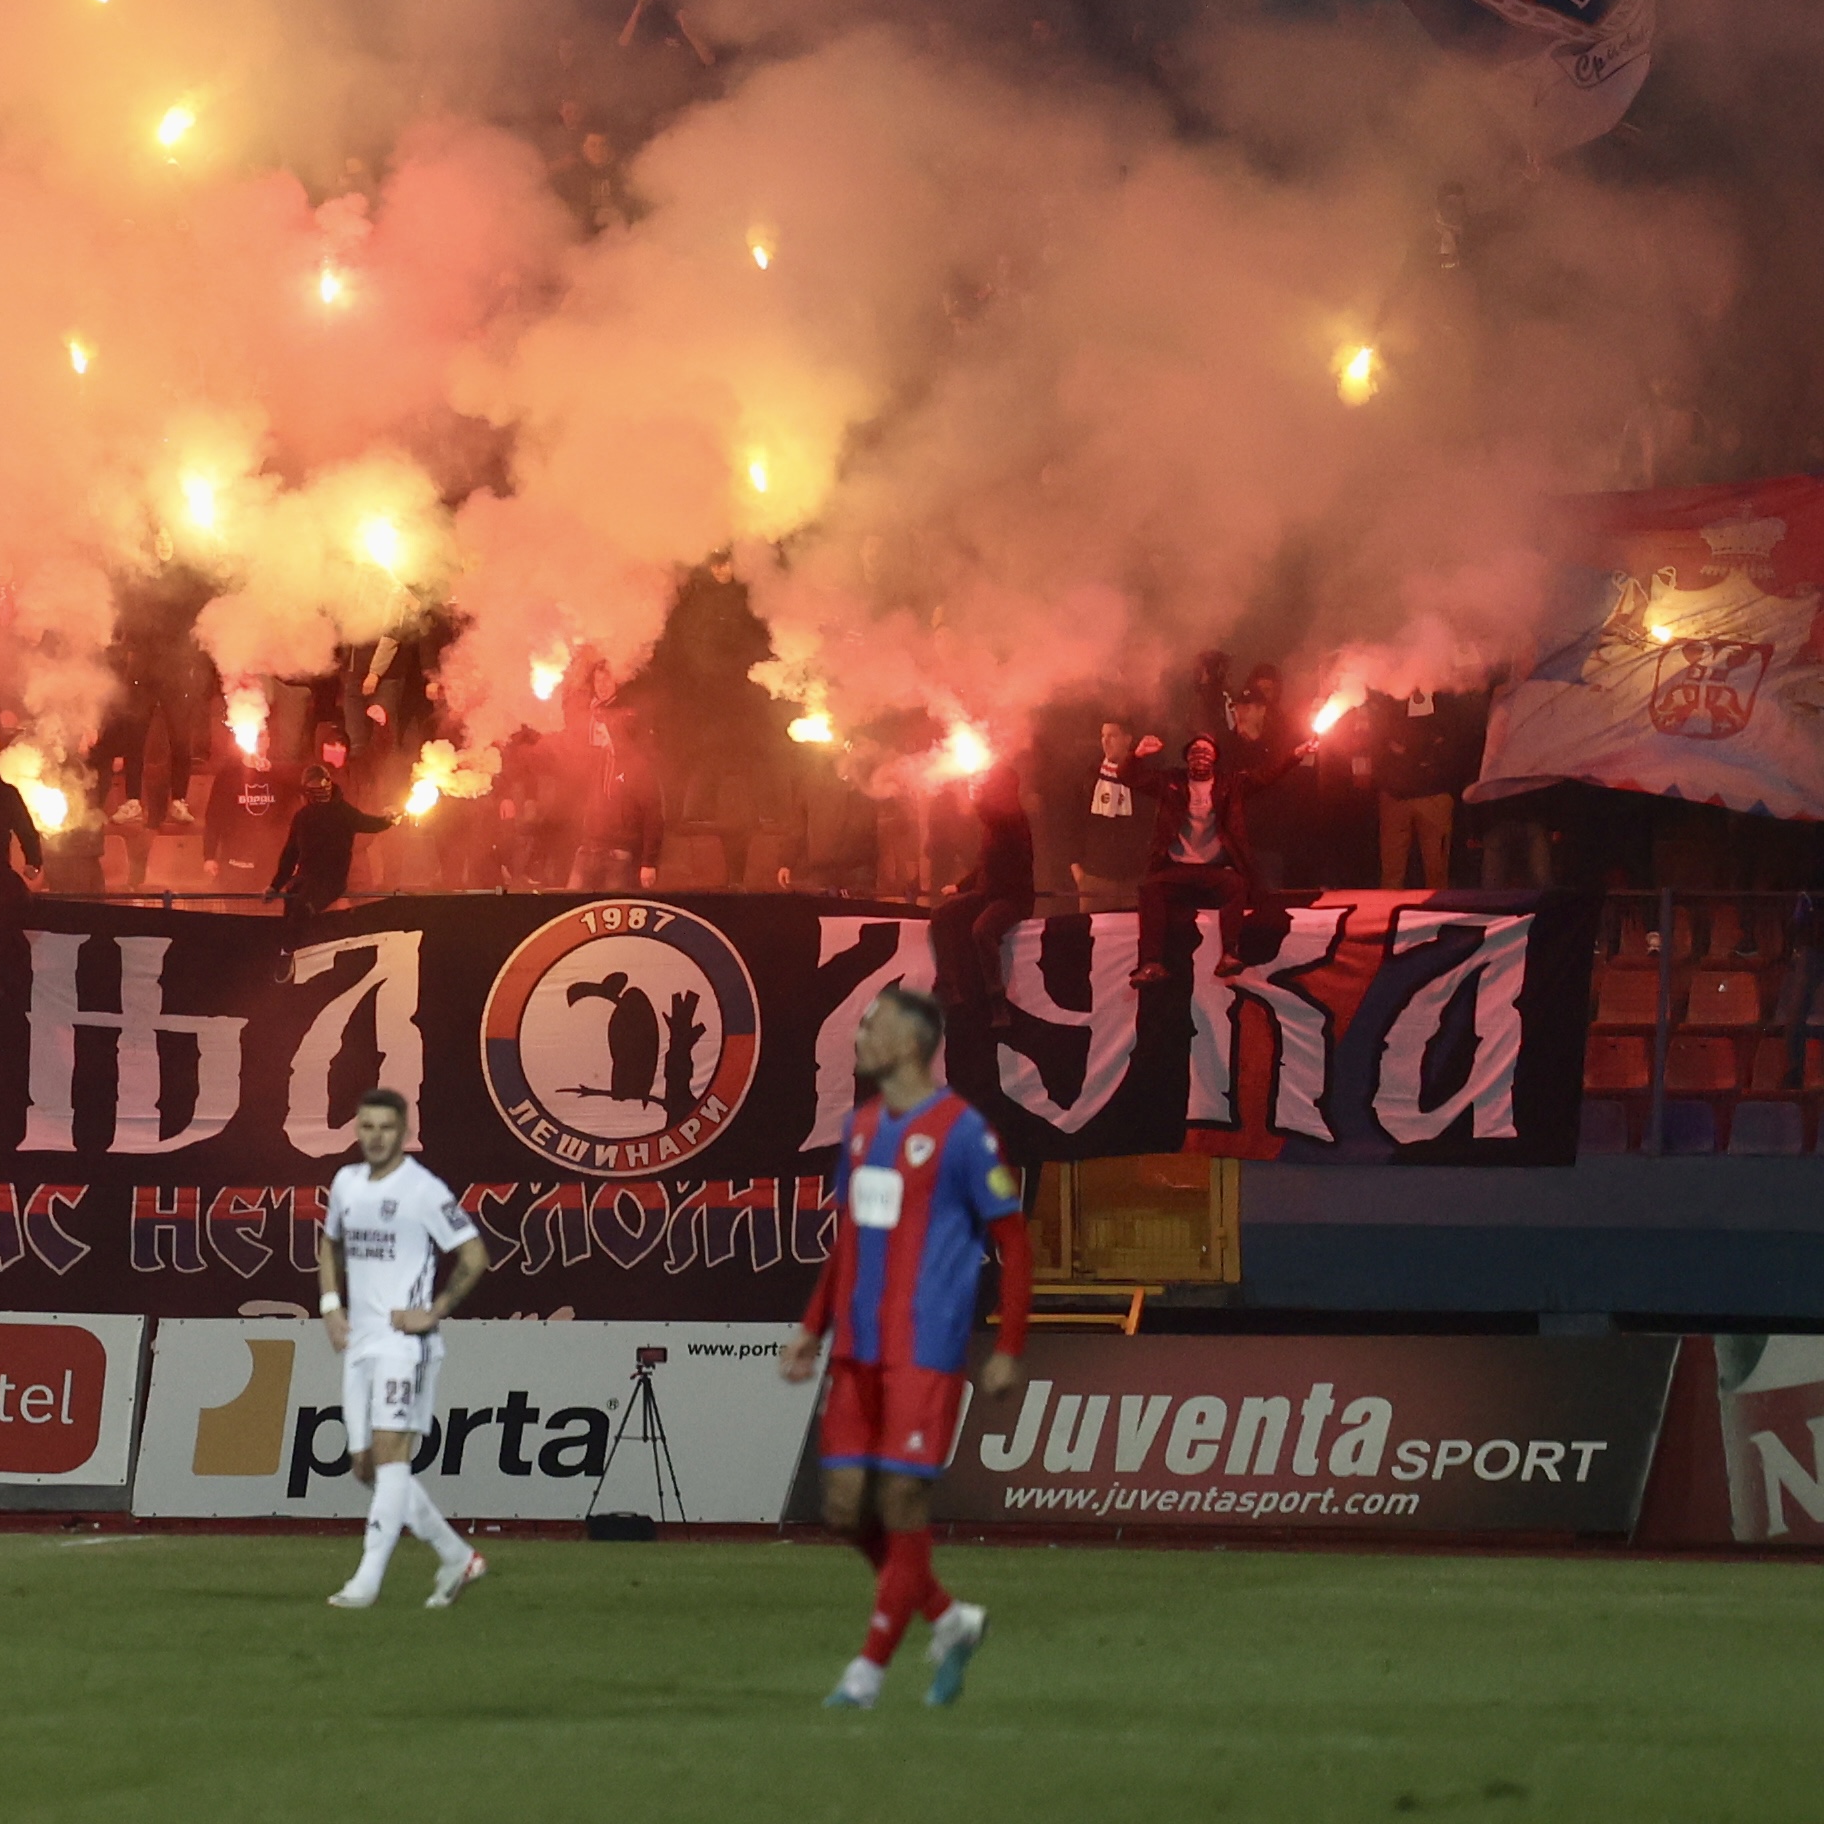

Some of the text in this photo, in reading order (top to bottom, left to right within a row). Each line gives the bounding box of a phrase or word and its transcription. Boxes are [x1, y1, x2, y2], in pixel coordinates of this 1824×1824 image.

[580, 907, 676, 934] 1987
[508, 1094, 729, 1168] ЛЕШИНАРИ
[980, 1380, 1608, 1482] Juventa SPORT
[1004, 1481, 1420, 1520] www.juventasport.com
